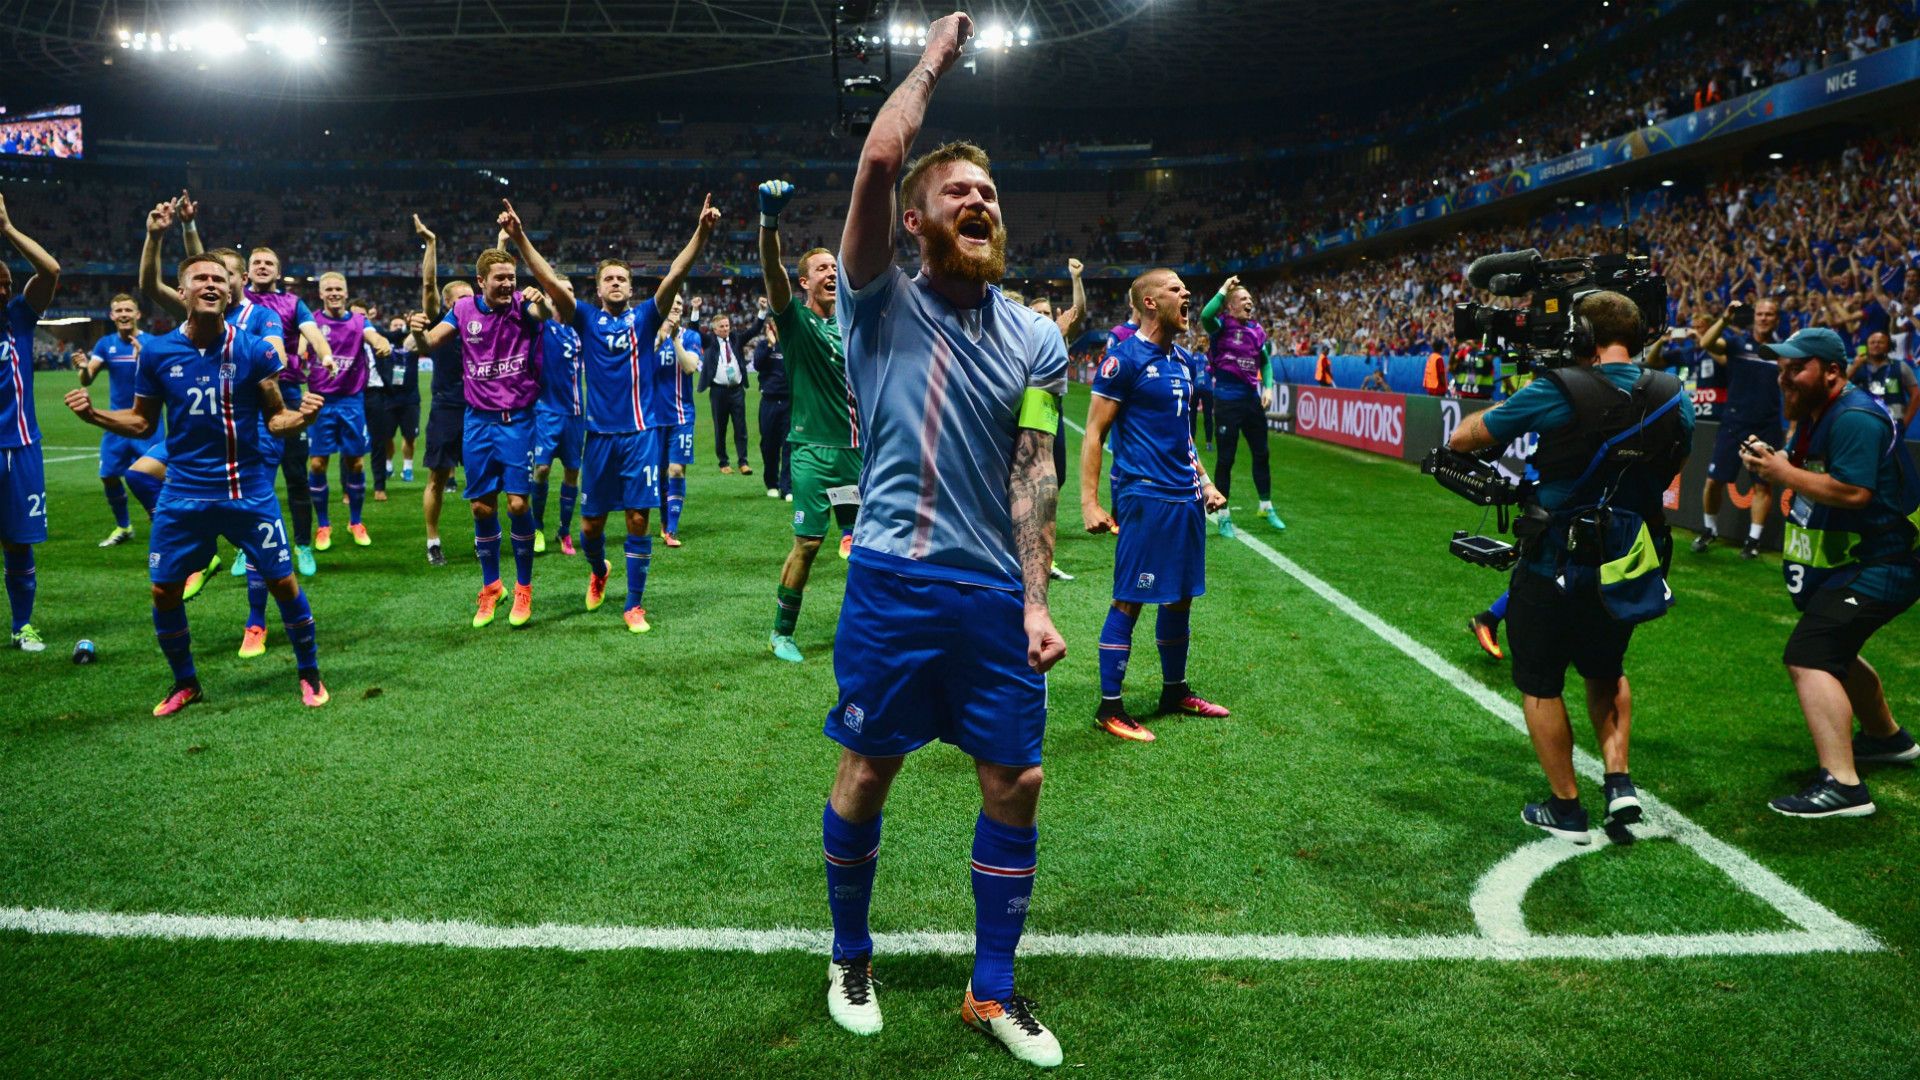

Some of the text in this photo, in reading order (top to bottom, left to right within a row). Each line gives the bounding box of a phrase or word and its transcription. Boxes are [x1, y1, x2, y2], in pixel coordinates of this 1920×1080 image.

[1826, 69, 1857, 94] NICE
[605, 334, 629, 352] 14
[477, 357, 525, 377] RESPECT
[659, 350, 674, 366] 15
[186, 387, 217, 415] 21
[1172, 388, 1184, 417] 7
[1300, 400, 1314, 421] KIA
[1318, 397, 1339, 432] KIA
[1341, 400, 1403, 446] MOTORS
[678, 433, 693, 449] 15
[257, 518, 287, 549] 21
[1788, 529, 1812, 561] HB
[1787, 564, 1805, 594] 3
